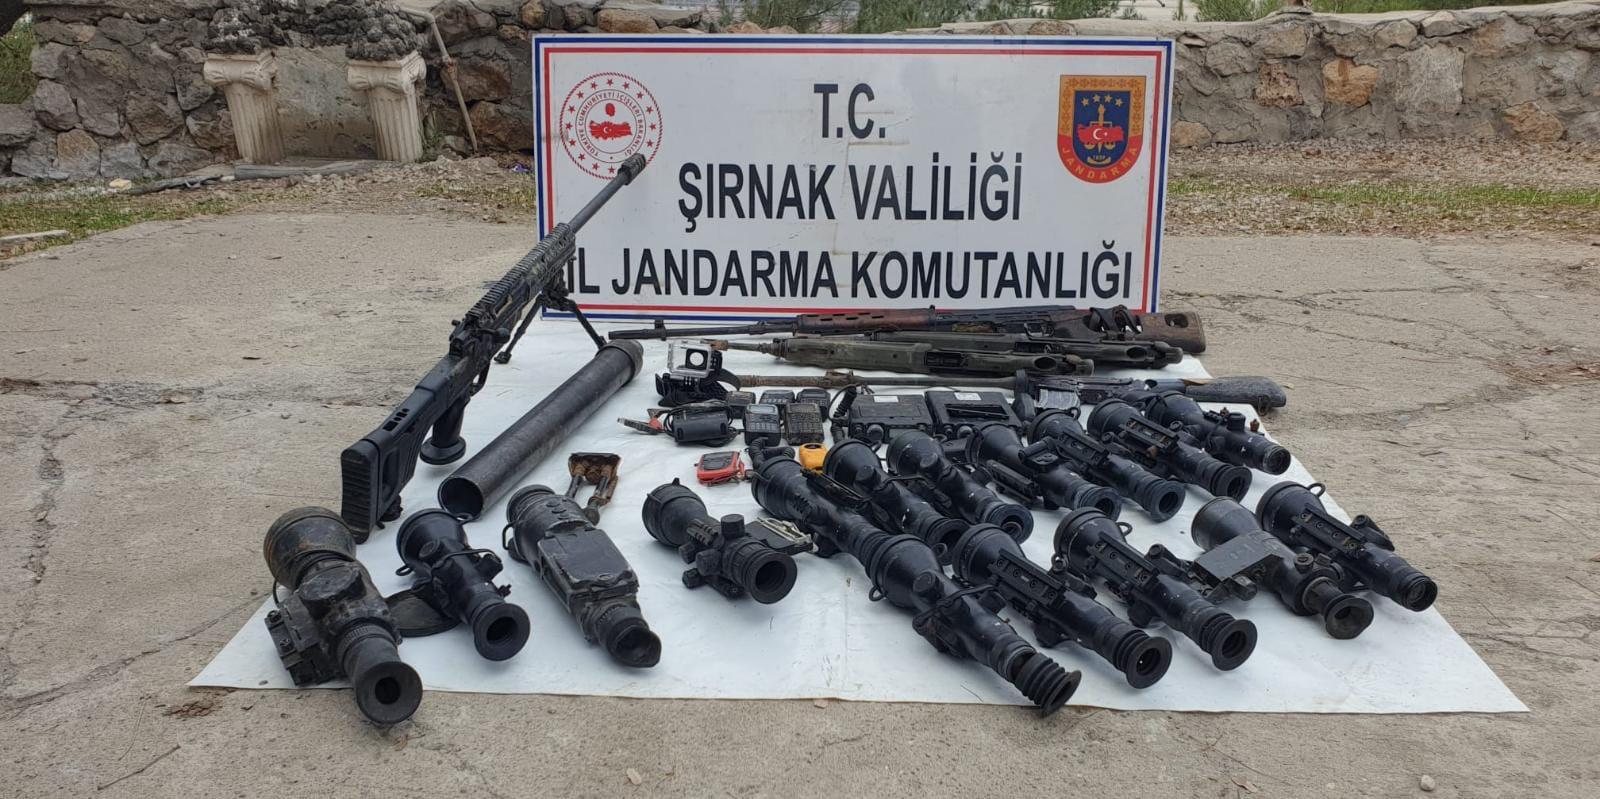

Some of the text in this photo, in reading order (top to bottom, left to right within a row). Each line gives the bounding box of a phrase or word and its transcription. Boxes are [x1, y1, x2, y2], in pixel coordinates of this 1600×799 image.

[814, 84, 886, 139] T.C.
[1062, 148, 1137, 179] JANDARMA
[679, 152, 1022, 233] ŞIRNAK VALİLİĞİ
[611, 248, 839, 298] JANDARMA
[851, 240, 1132, 300] KOMUTANLIĞI
